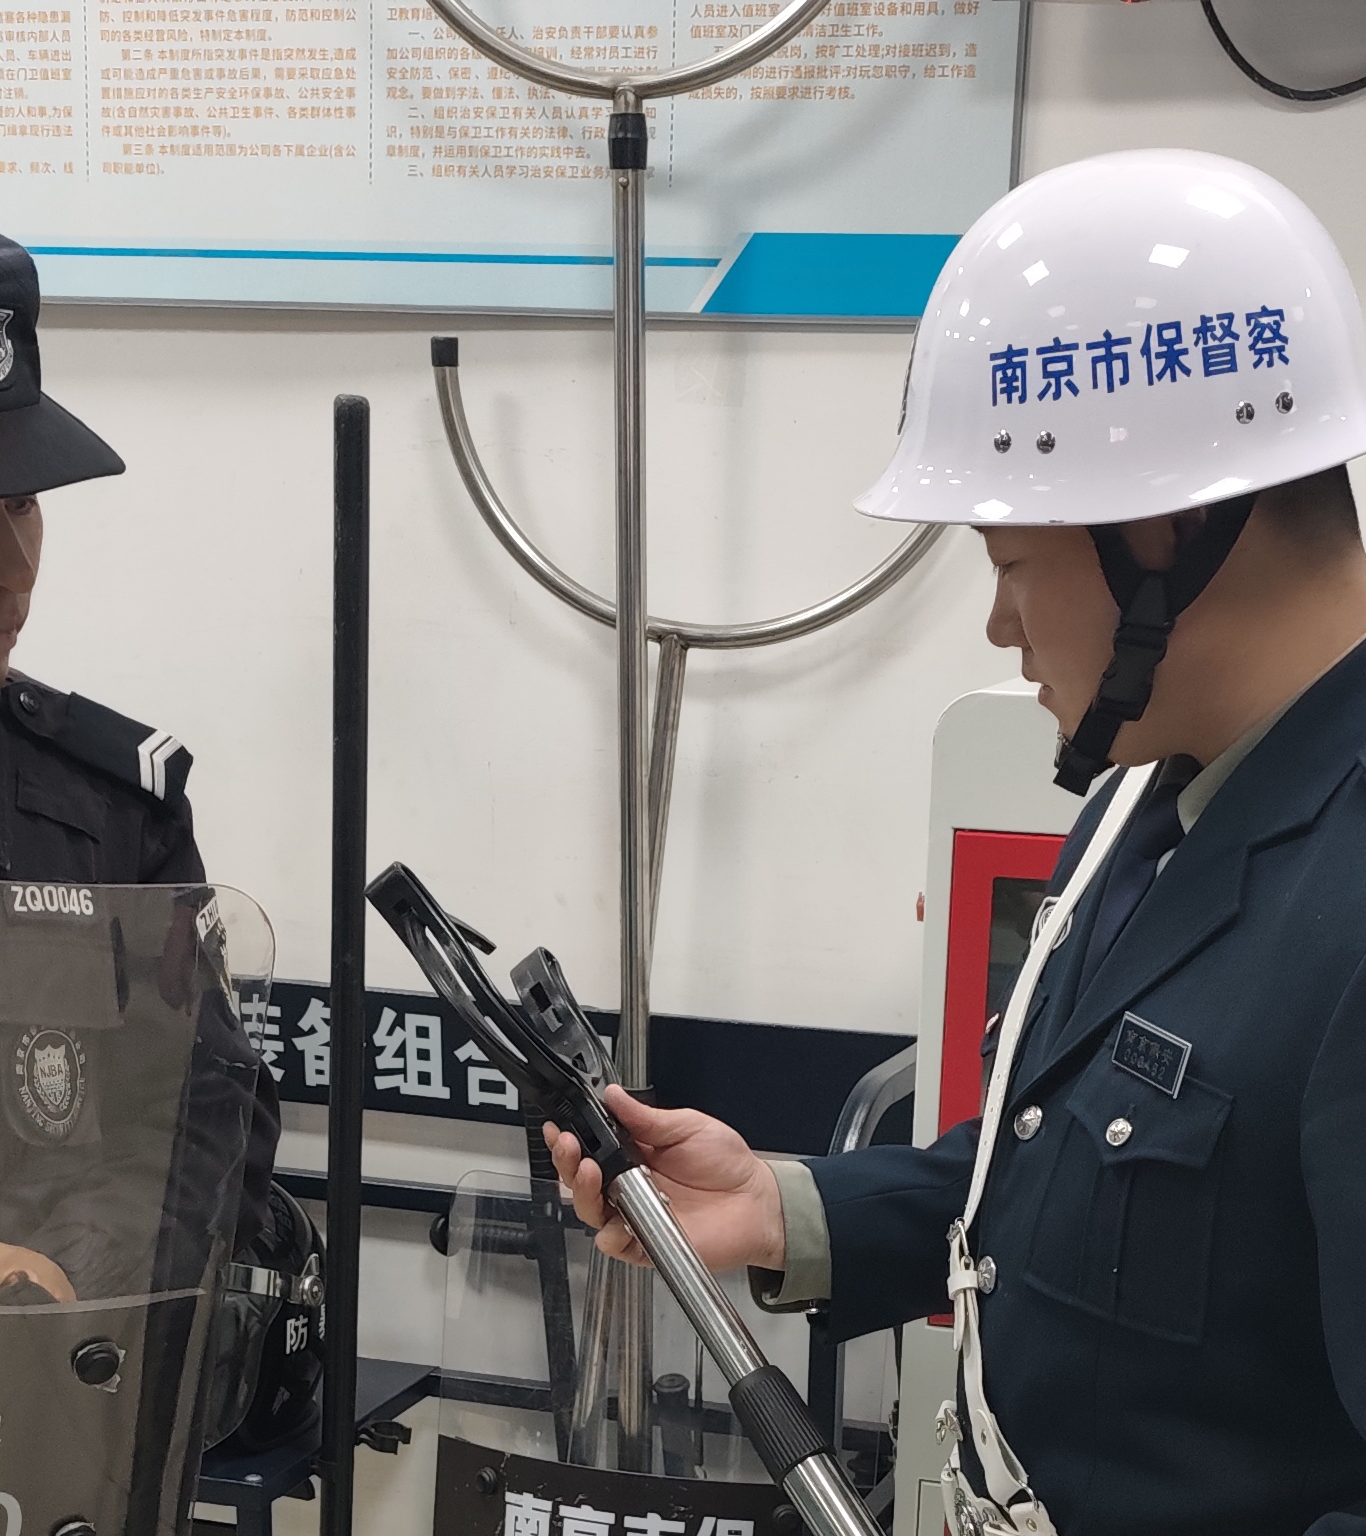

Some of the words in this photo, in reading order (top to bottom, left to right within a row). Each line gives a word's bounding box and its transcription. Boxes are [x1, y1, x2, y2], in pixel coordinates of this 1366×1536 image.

[989, 304, 1290, 407] 南京市保督察
[10, 885, 94, 916] ZQ0046
